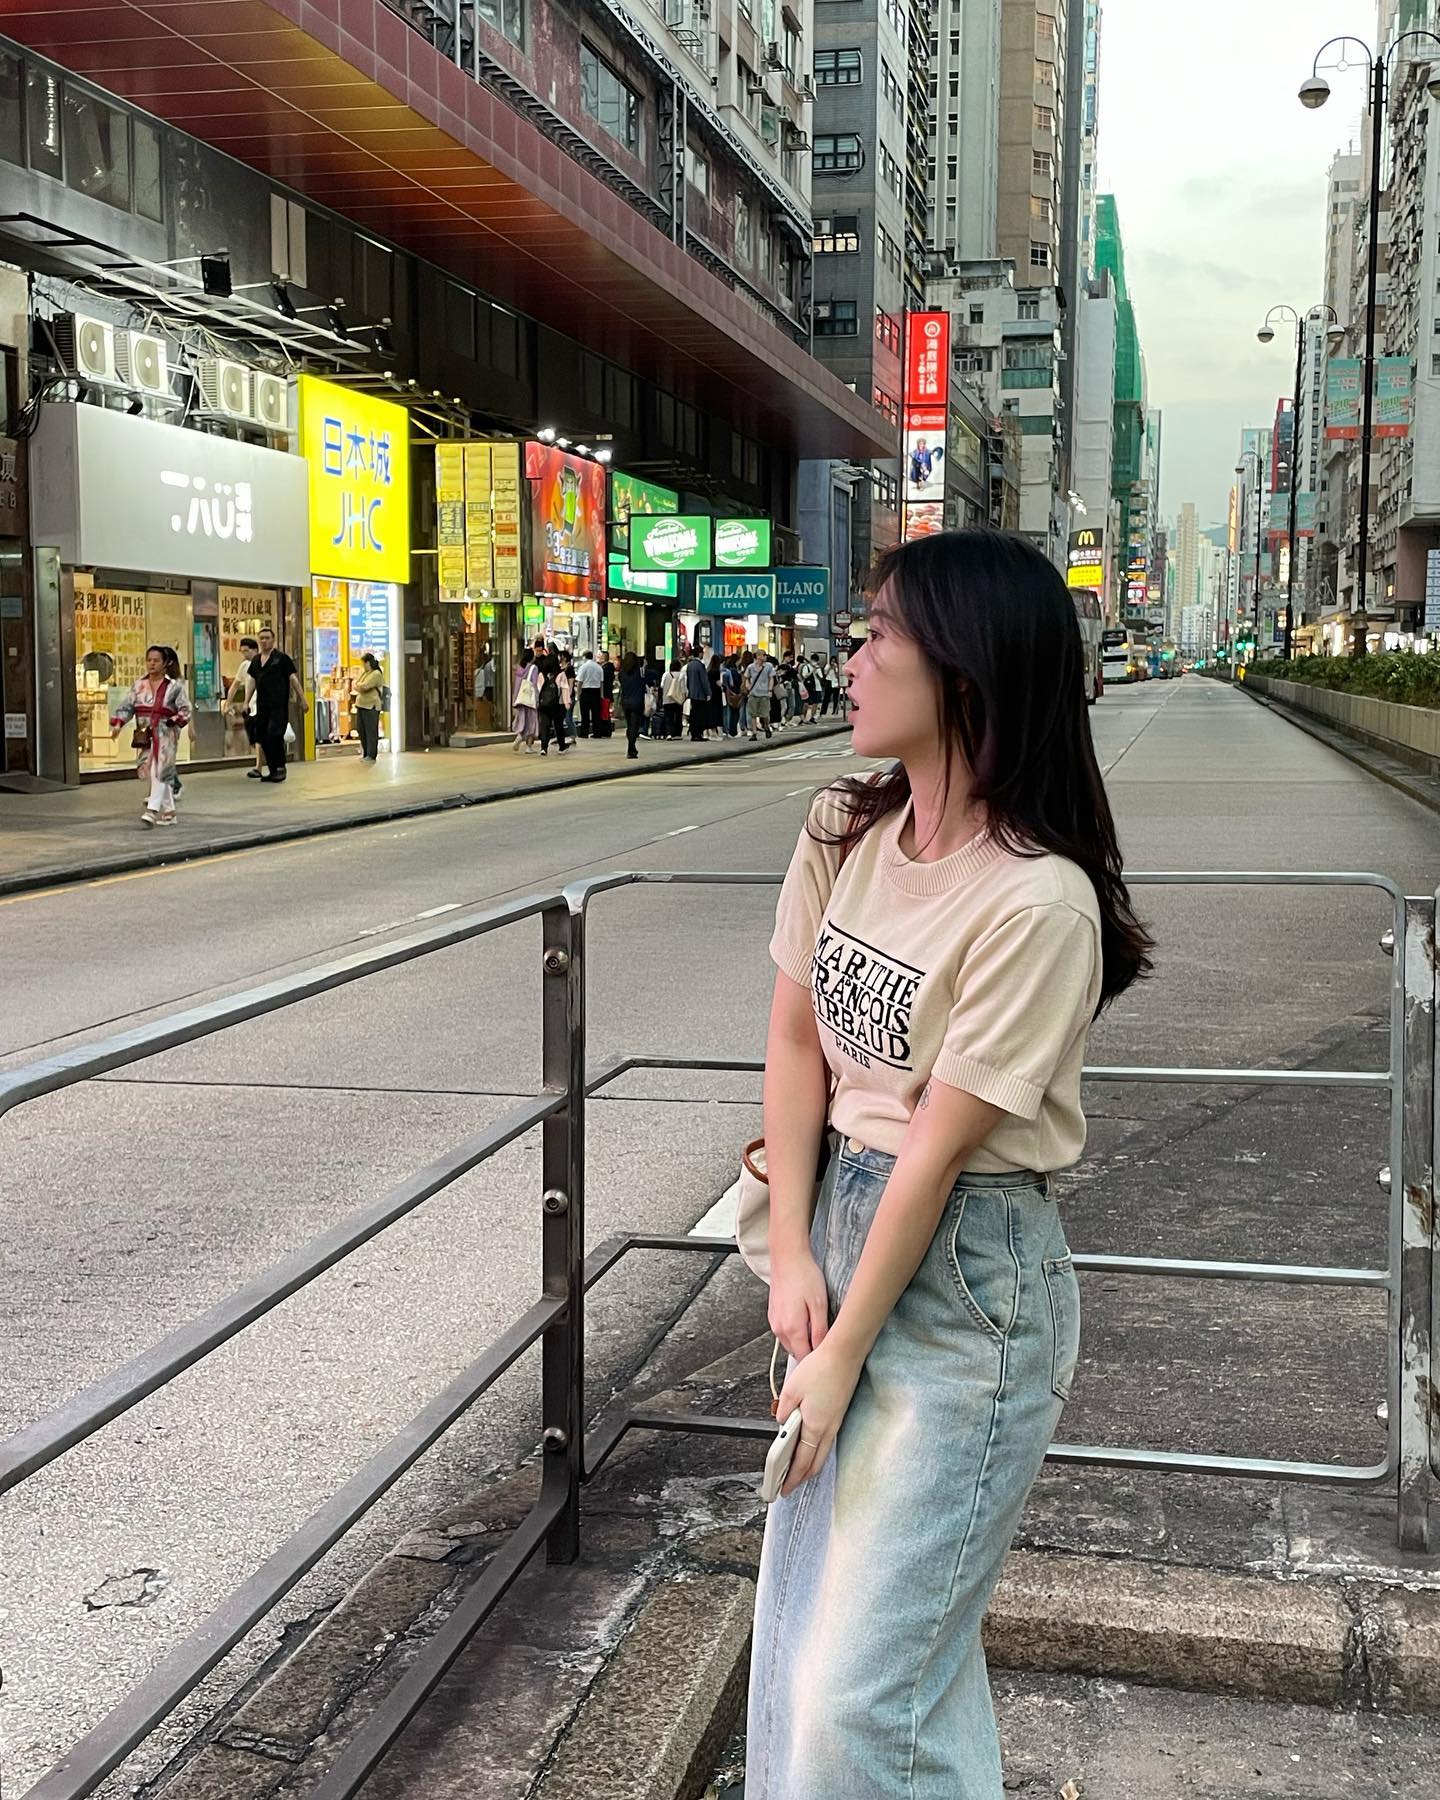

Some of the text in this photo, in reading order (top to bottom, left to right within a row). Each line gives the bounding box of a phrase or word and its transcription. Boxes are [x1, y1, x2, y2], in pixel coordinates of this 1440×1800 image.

[324, 416, 390, 484] 日本城
[332, 491, 382, 551] JHC
[703, 584, 769, 599] MILANO
[777, 582, 825, 596] ILANO
[782, 597, 806, 605] ITALY
[722, 602, 748, 610] ITALY
[835, 638, 852, 647] N45
[813, 929, 920, 1010] MARITHÉ
[813, 989, 911, 1062] IRBAUD
[835, 1035, 871, 1069] PARIS
